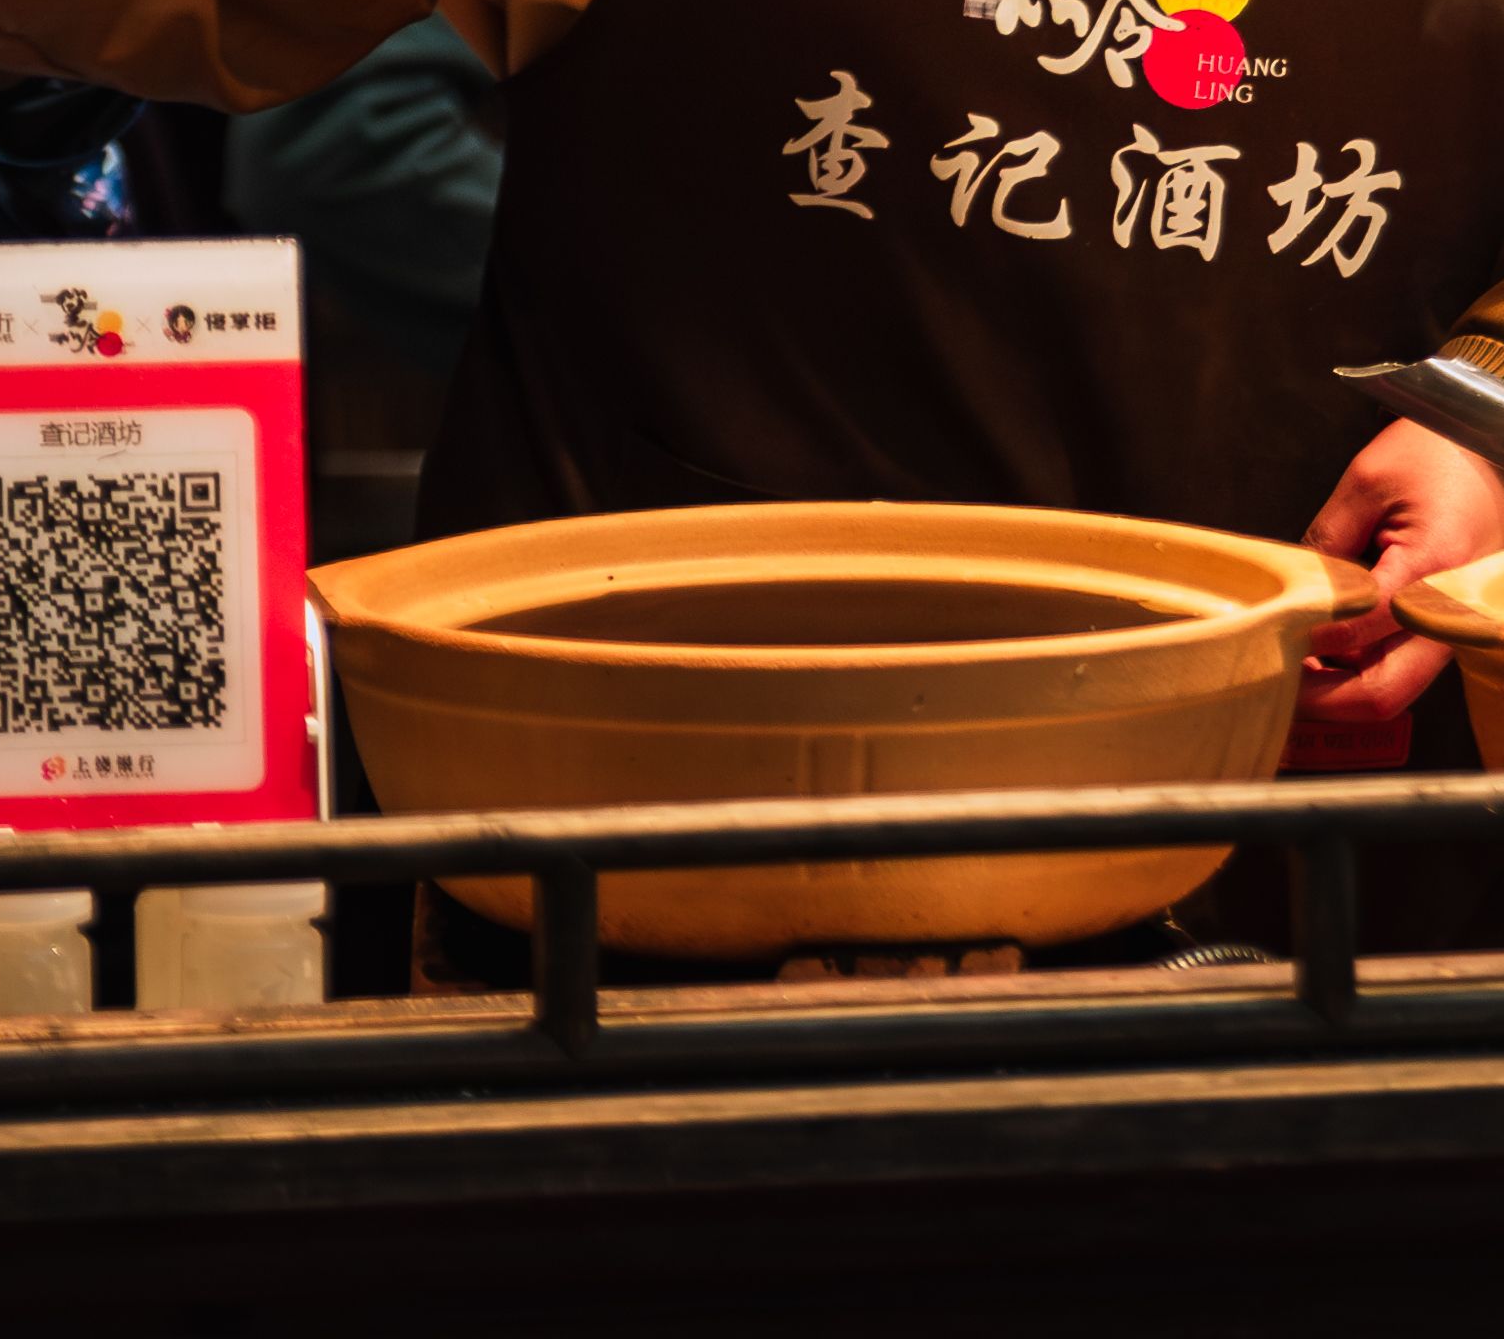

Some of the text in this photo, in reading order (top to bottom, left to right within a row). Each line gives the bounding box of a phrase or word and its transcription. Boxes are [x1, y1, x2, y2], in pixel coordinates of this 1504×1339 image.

[1197, 53, 1288, 78] HUANG
[1193, 80, 1254, 104] LING
[781, 69, 1403, 278] 查记酒坊
[39, 418, 143, 448] 查记酒坊
